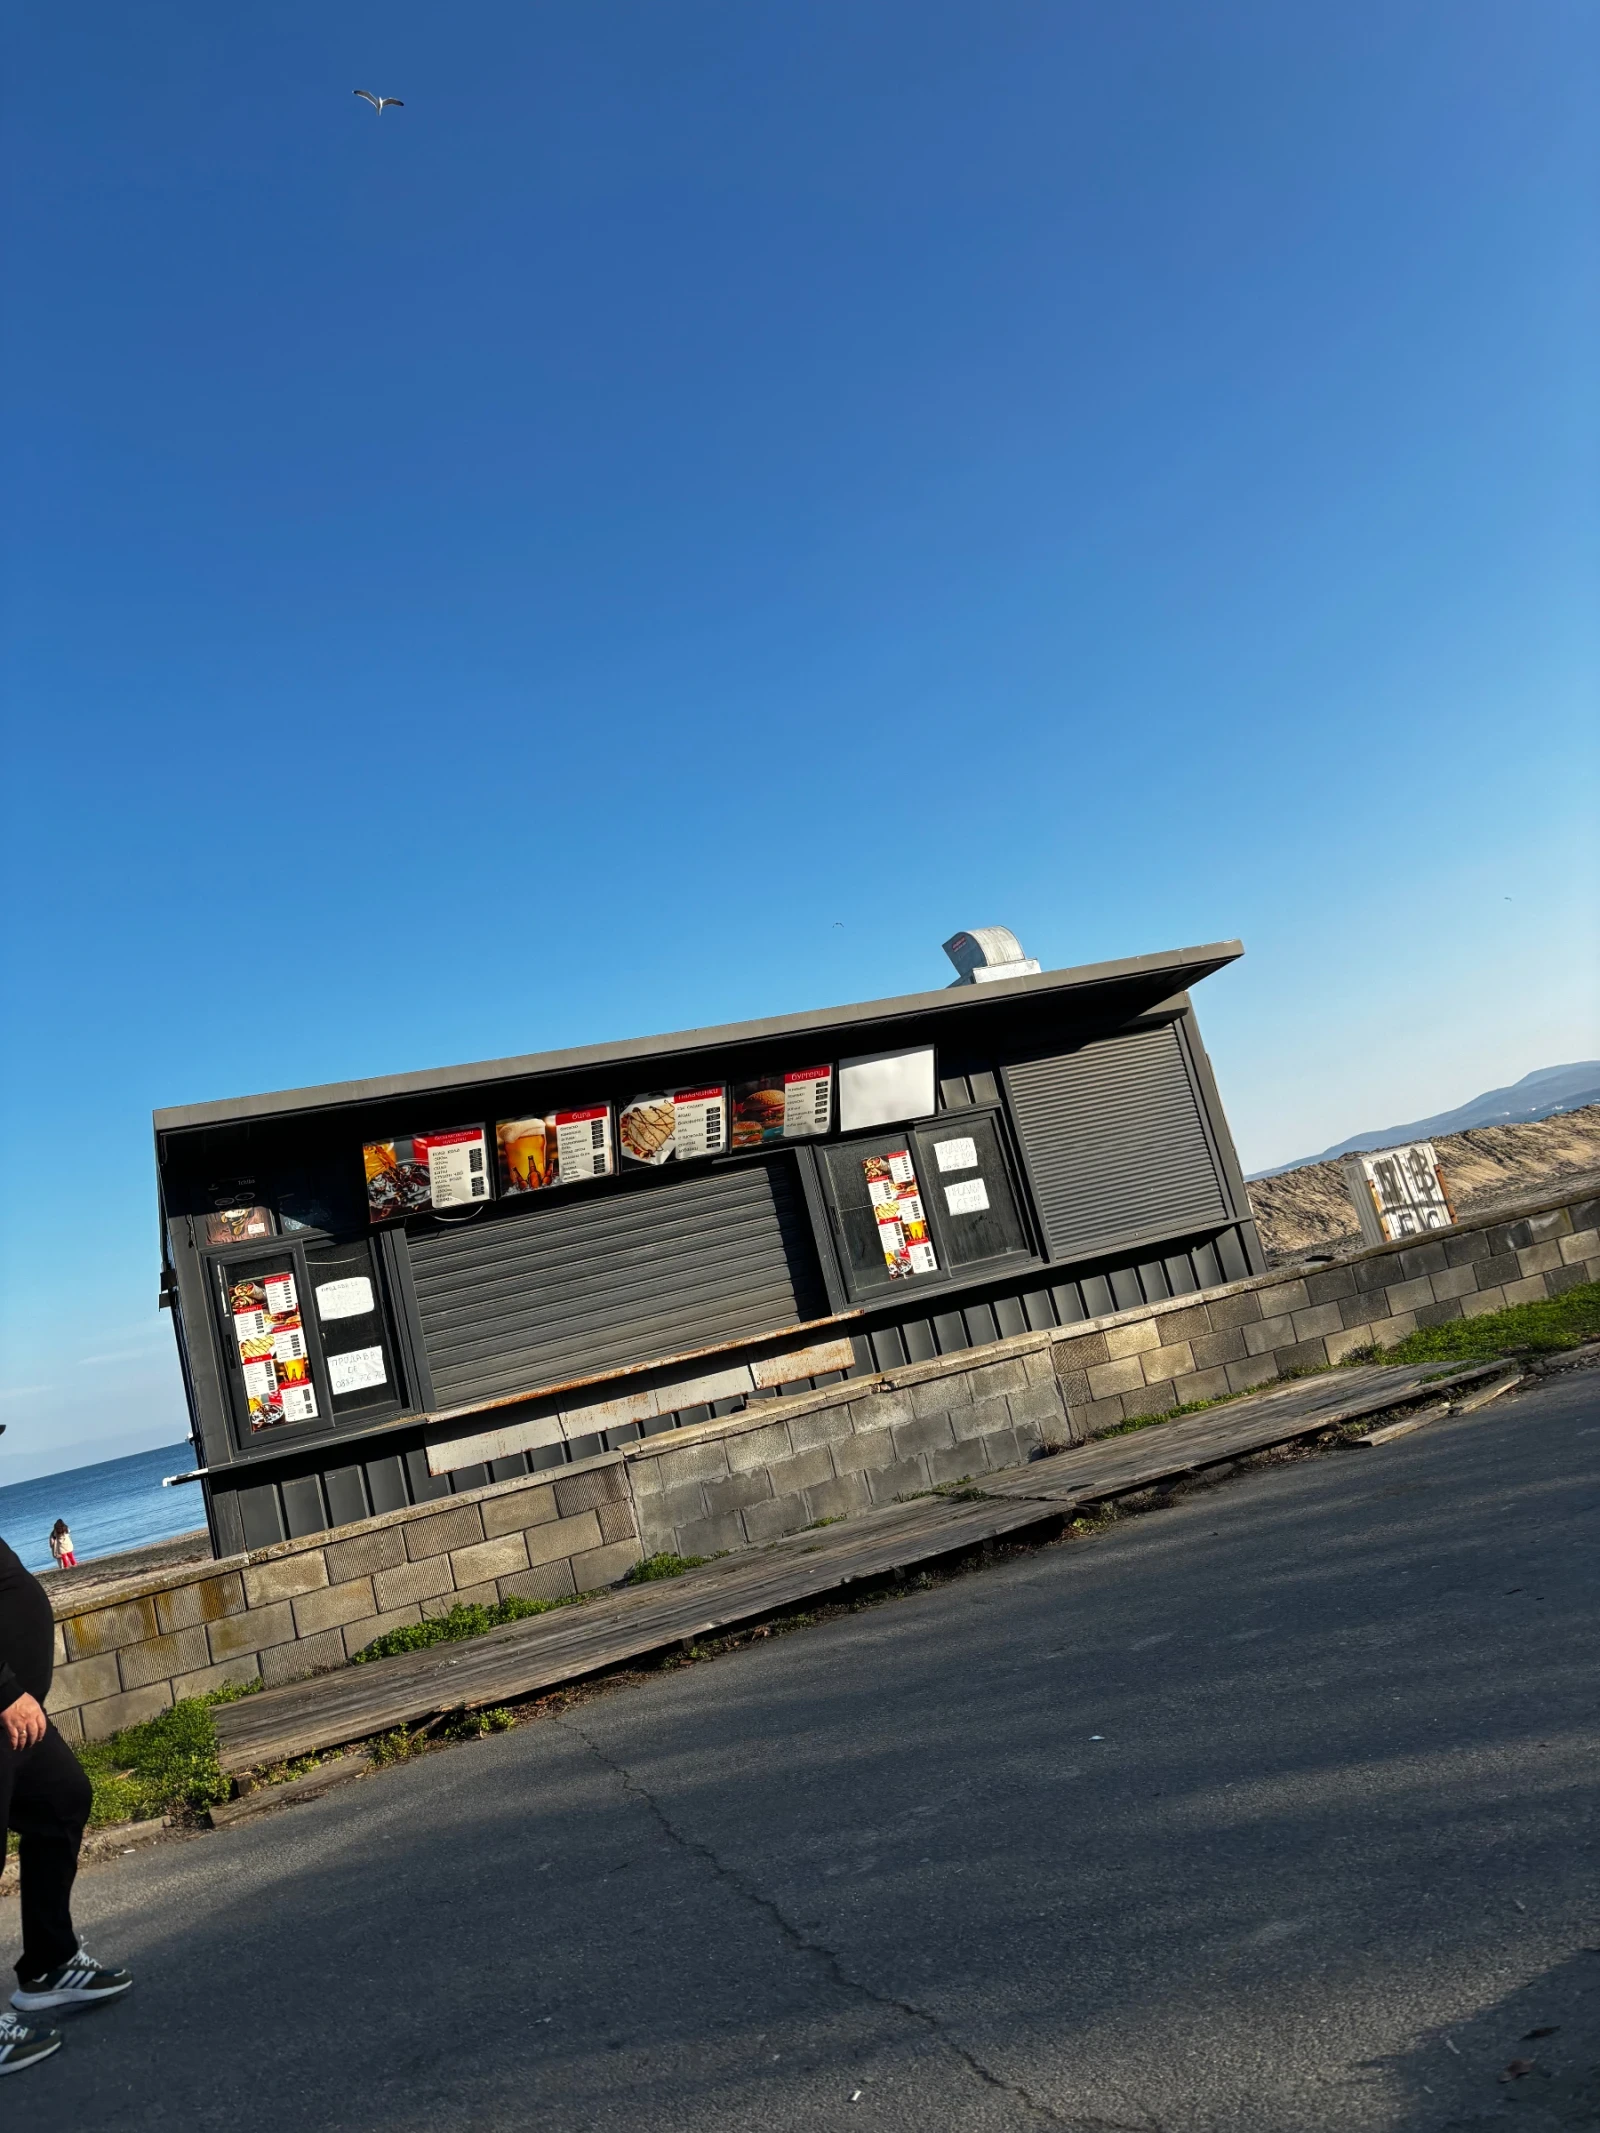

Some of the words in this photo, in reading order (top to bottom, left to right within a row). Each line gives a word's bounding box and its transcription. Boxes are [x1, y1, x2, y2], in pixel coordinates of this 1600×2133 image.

[791, 1070, 824, 1080] бургери
[572, 1111, 591, 1120] бира
[331, 1351, 376, 1367] ПРОДАВА
